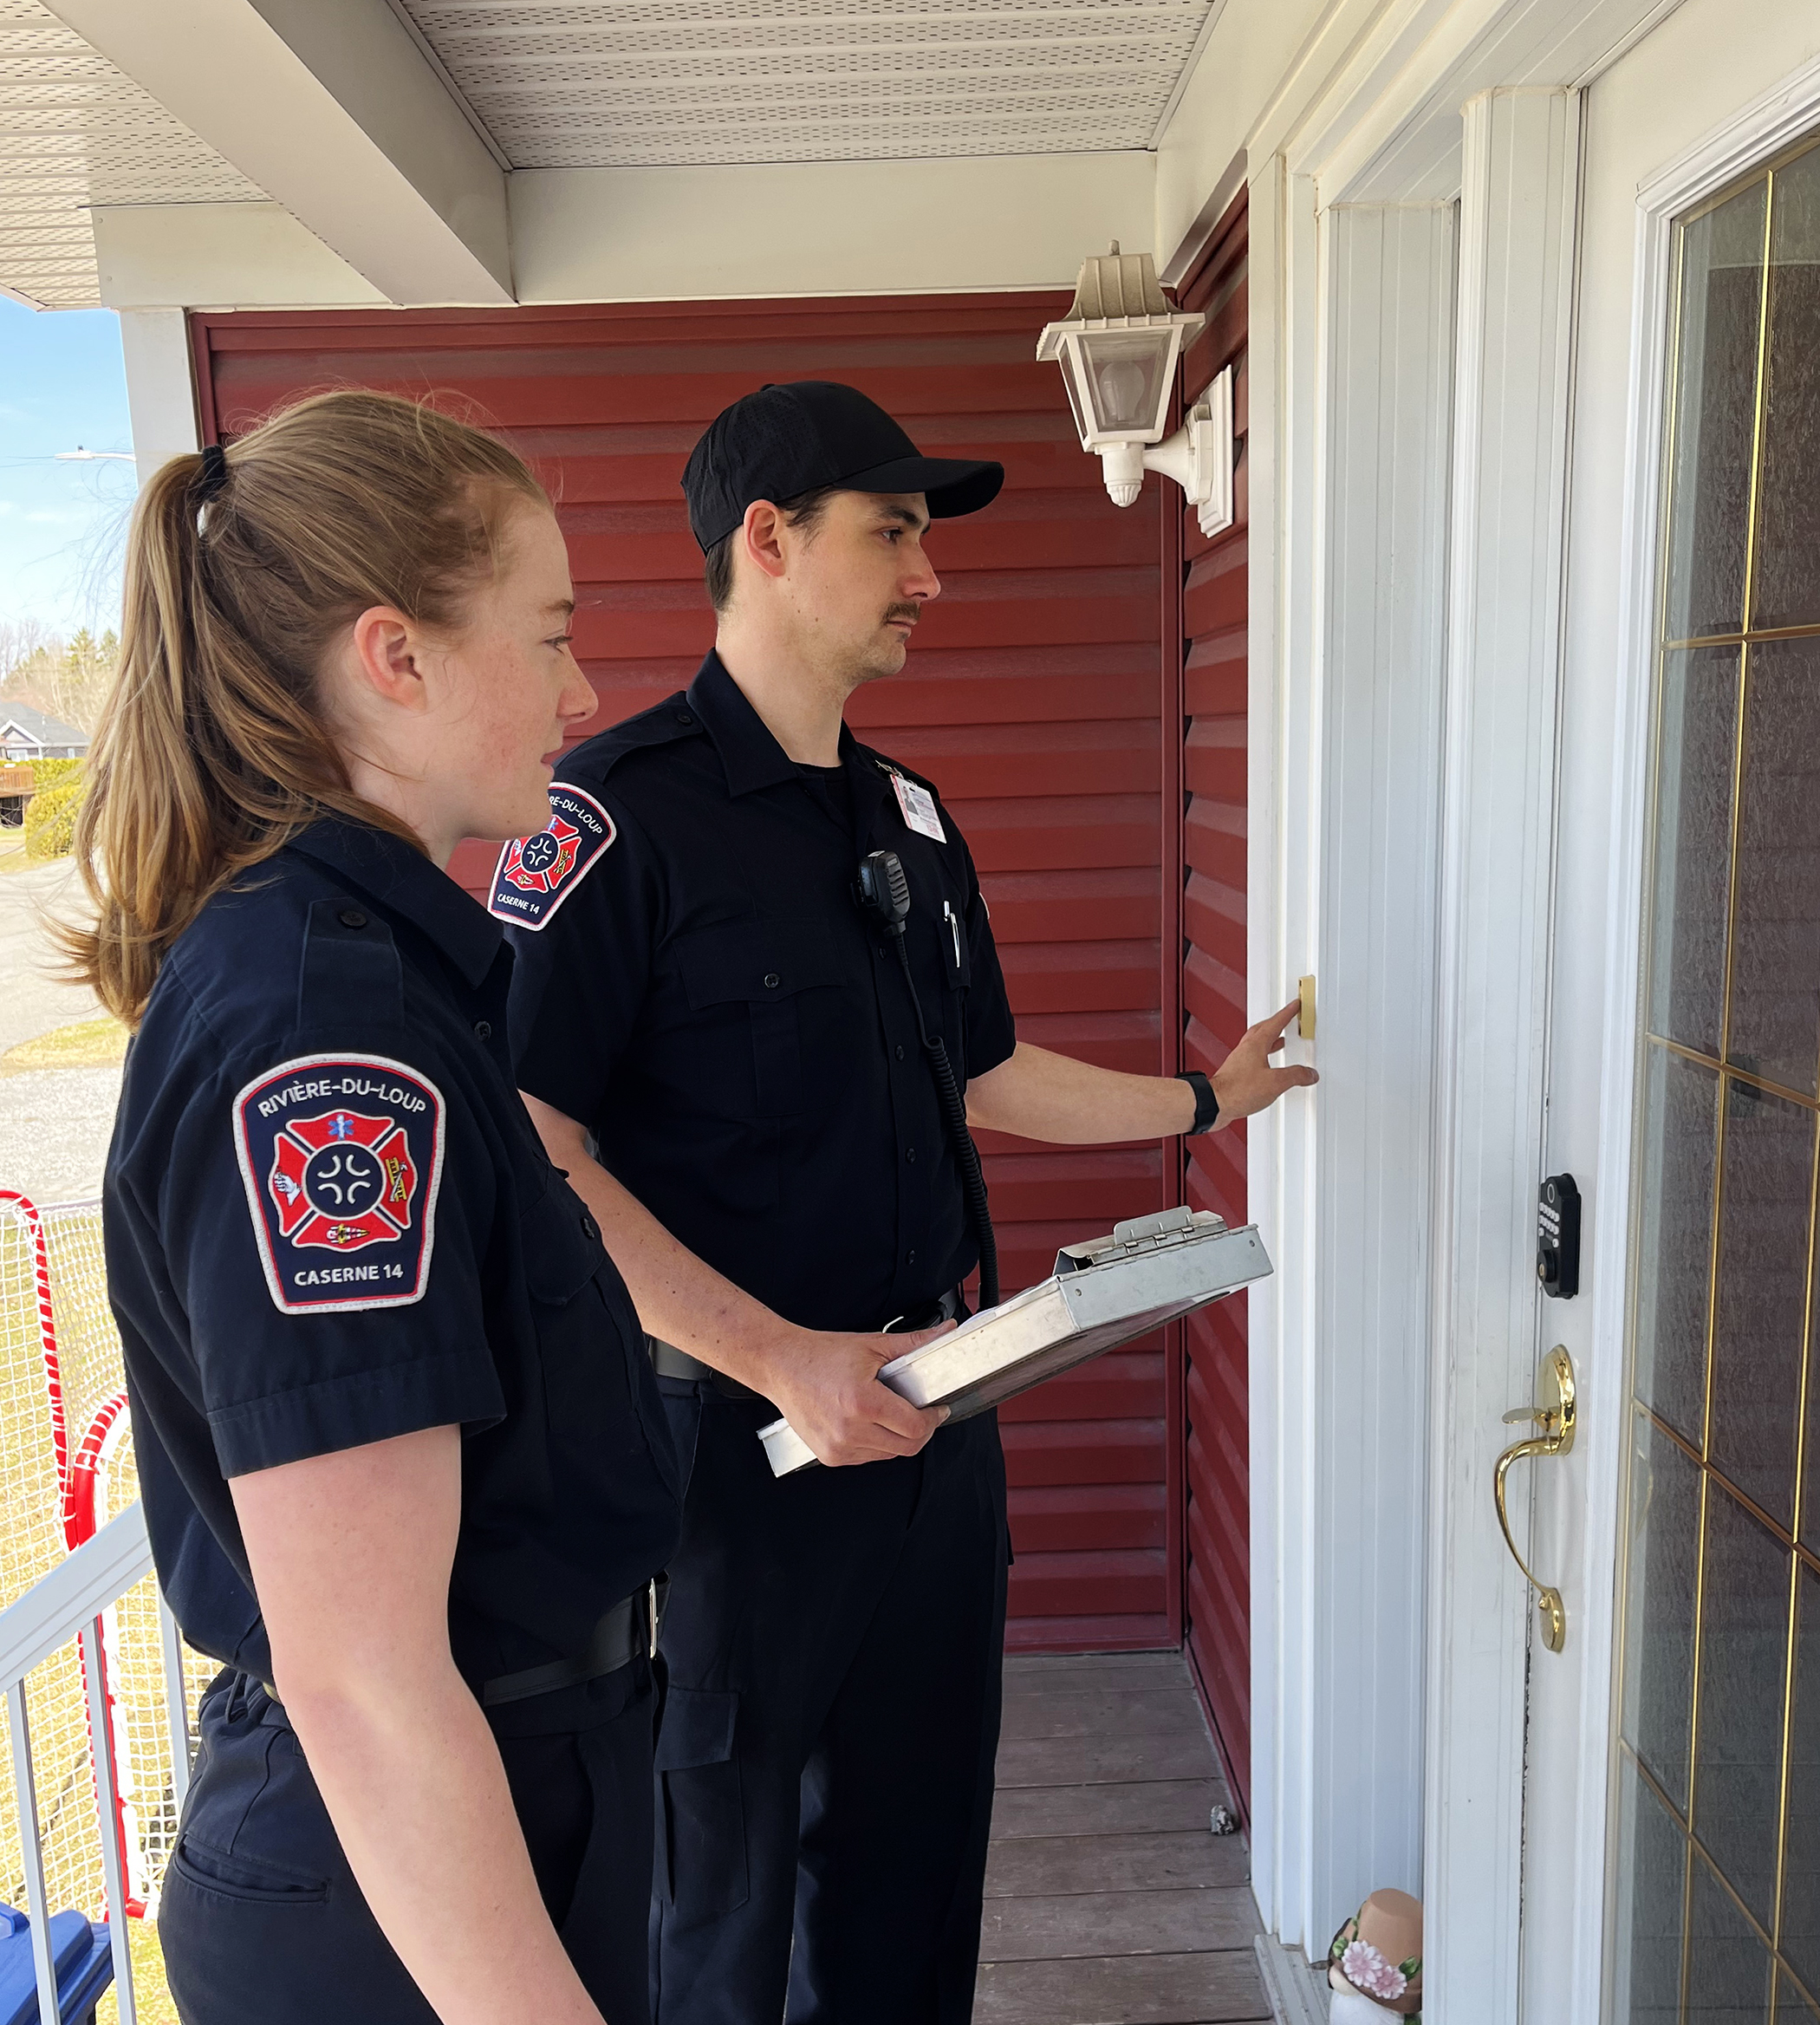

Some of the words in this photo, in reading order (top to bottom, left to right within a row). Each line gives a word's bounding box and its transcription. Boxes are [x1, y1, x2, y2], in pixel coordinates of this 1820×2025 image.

[548, 795, 603, 834] RE-DU-LOUP
[497, 893, 529, 910] CASERNE
[530, 903, 540, 915] 14
[257, 1079, 426, 1117] RIVIÈRE-DU-LOUP
[294, 1265, 380, 1286] CASERNE
[382, 1263, 404, 1279] 14
